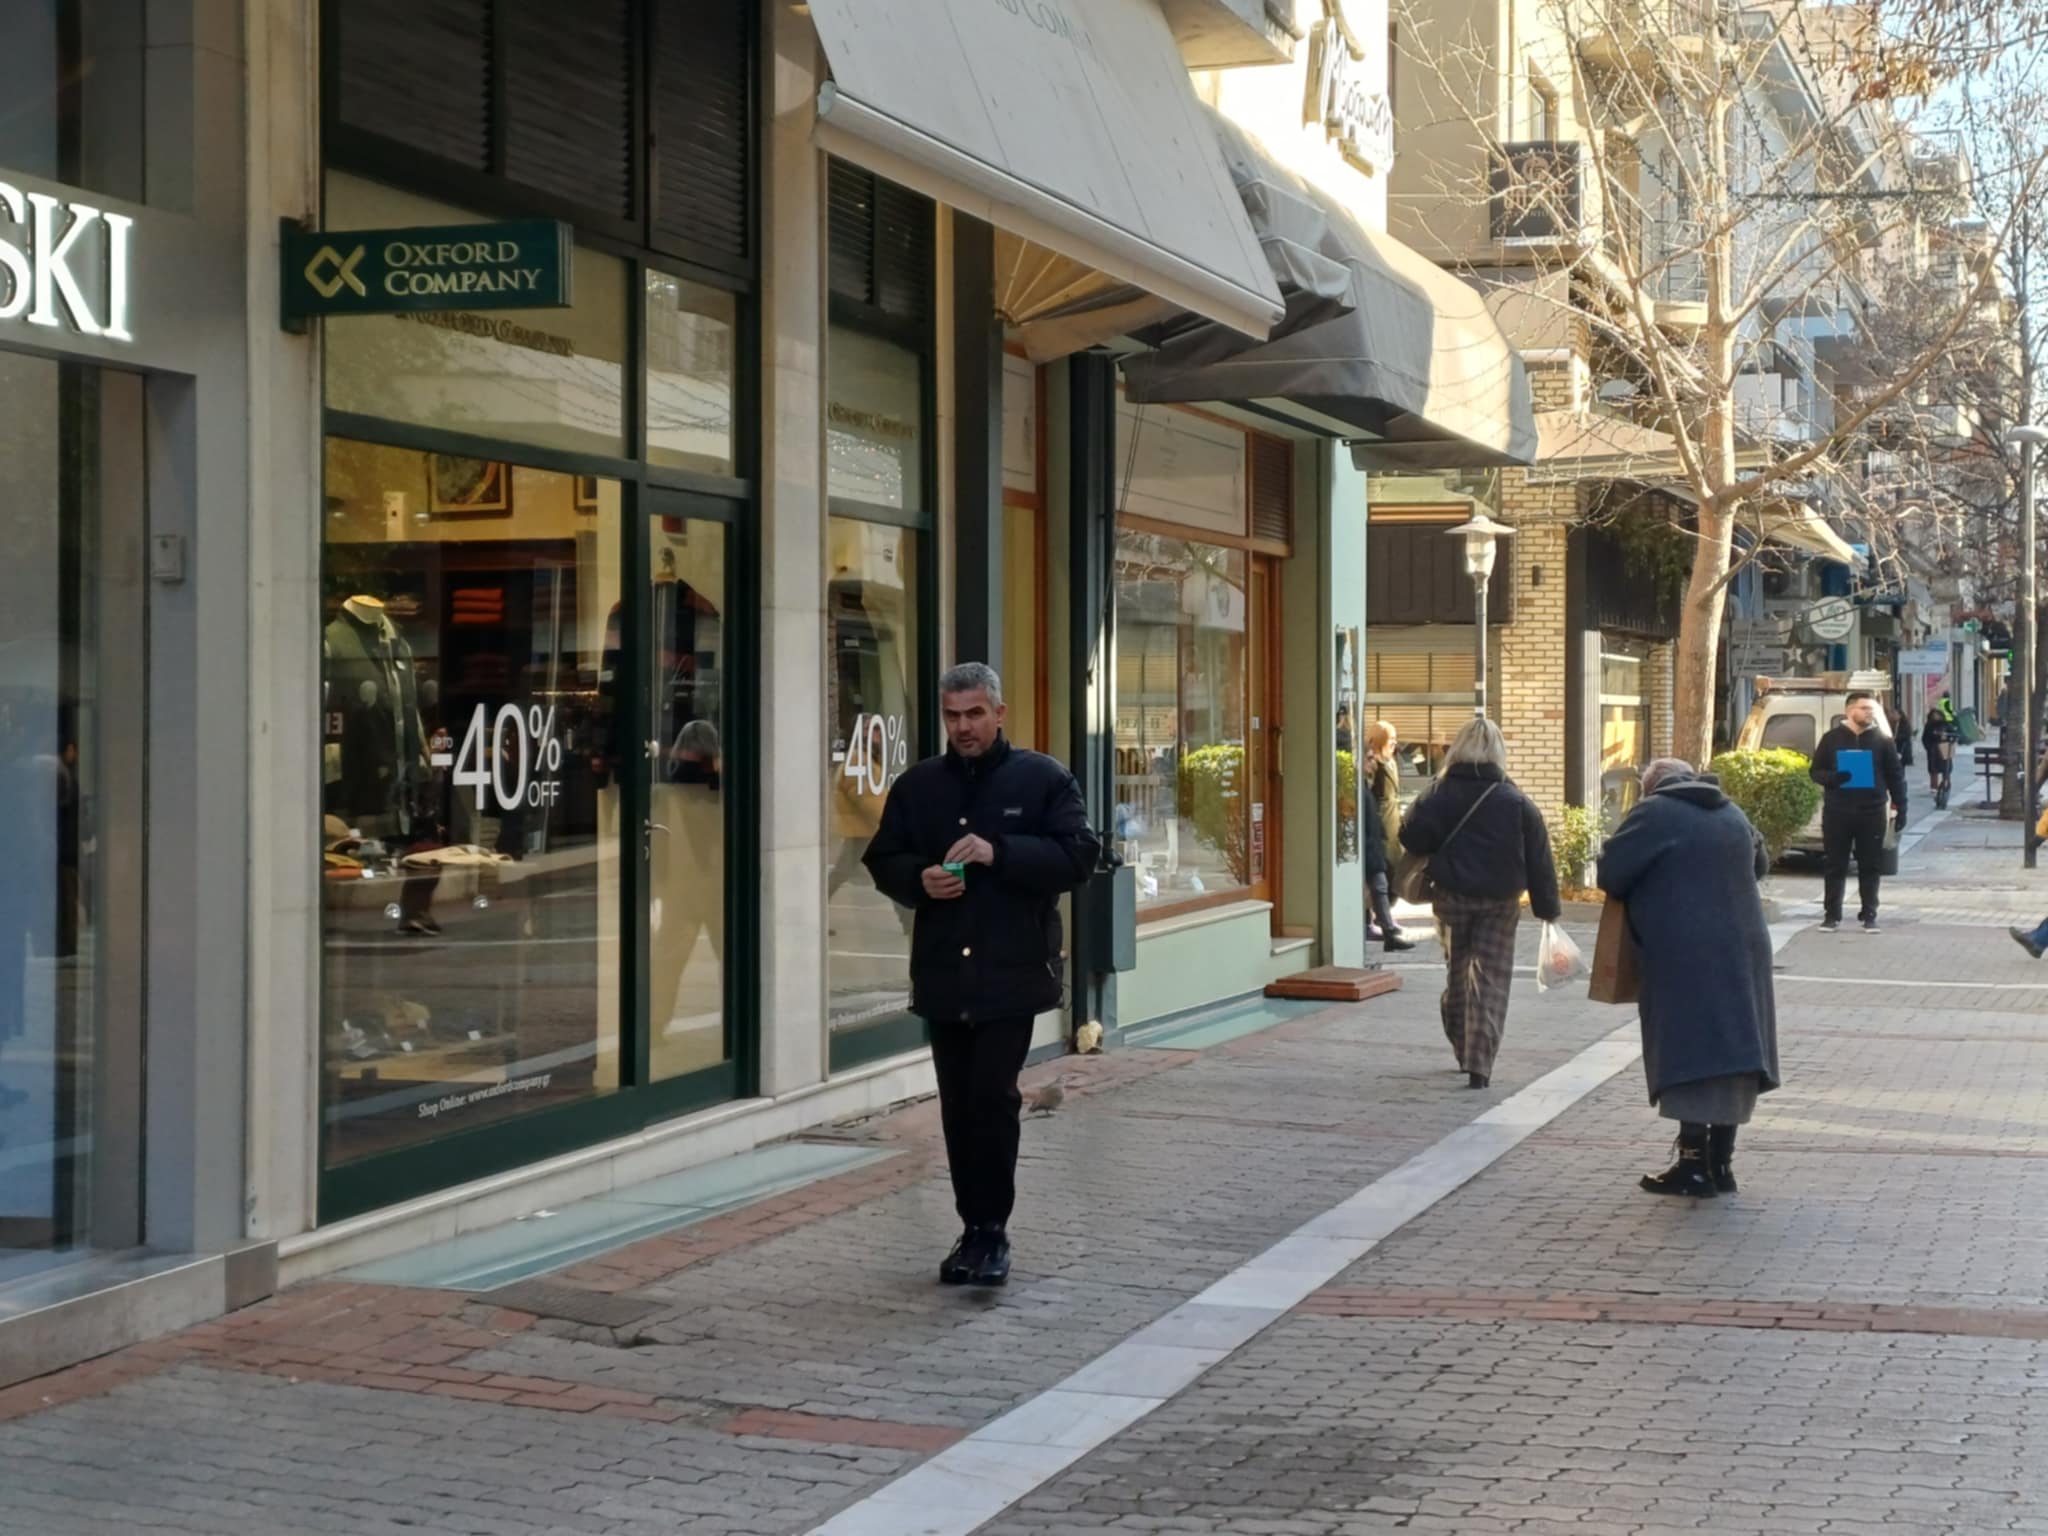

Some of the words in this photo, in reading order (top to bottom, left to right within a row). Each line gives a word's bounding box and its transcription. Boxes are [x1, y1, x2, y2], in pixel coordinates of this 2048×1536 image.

[0, 181, 133, 342] SKI
[384, 241, 520, 267] OXFORD
[384, 268, 543, 295] COMPANY
[528, 781, 560, 807] OFF
